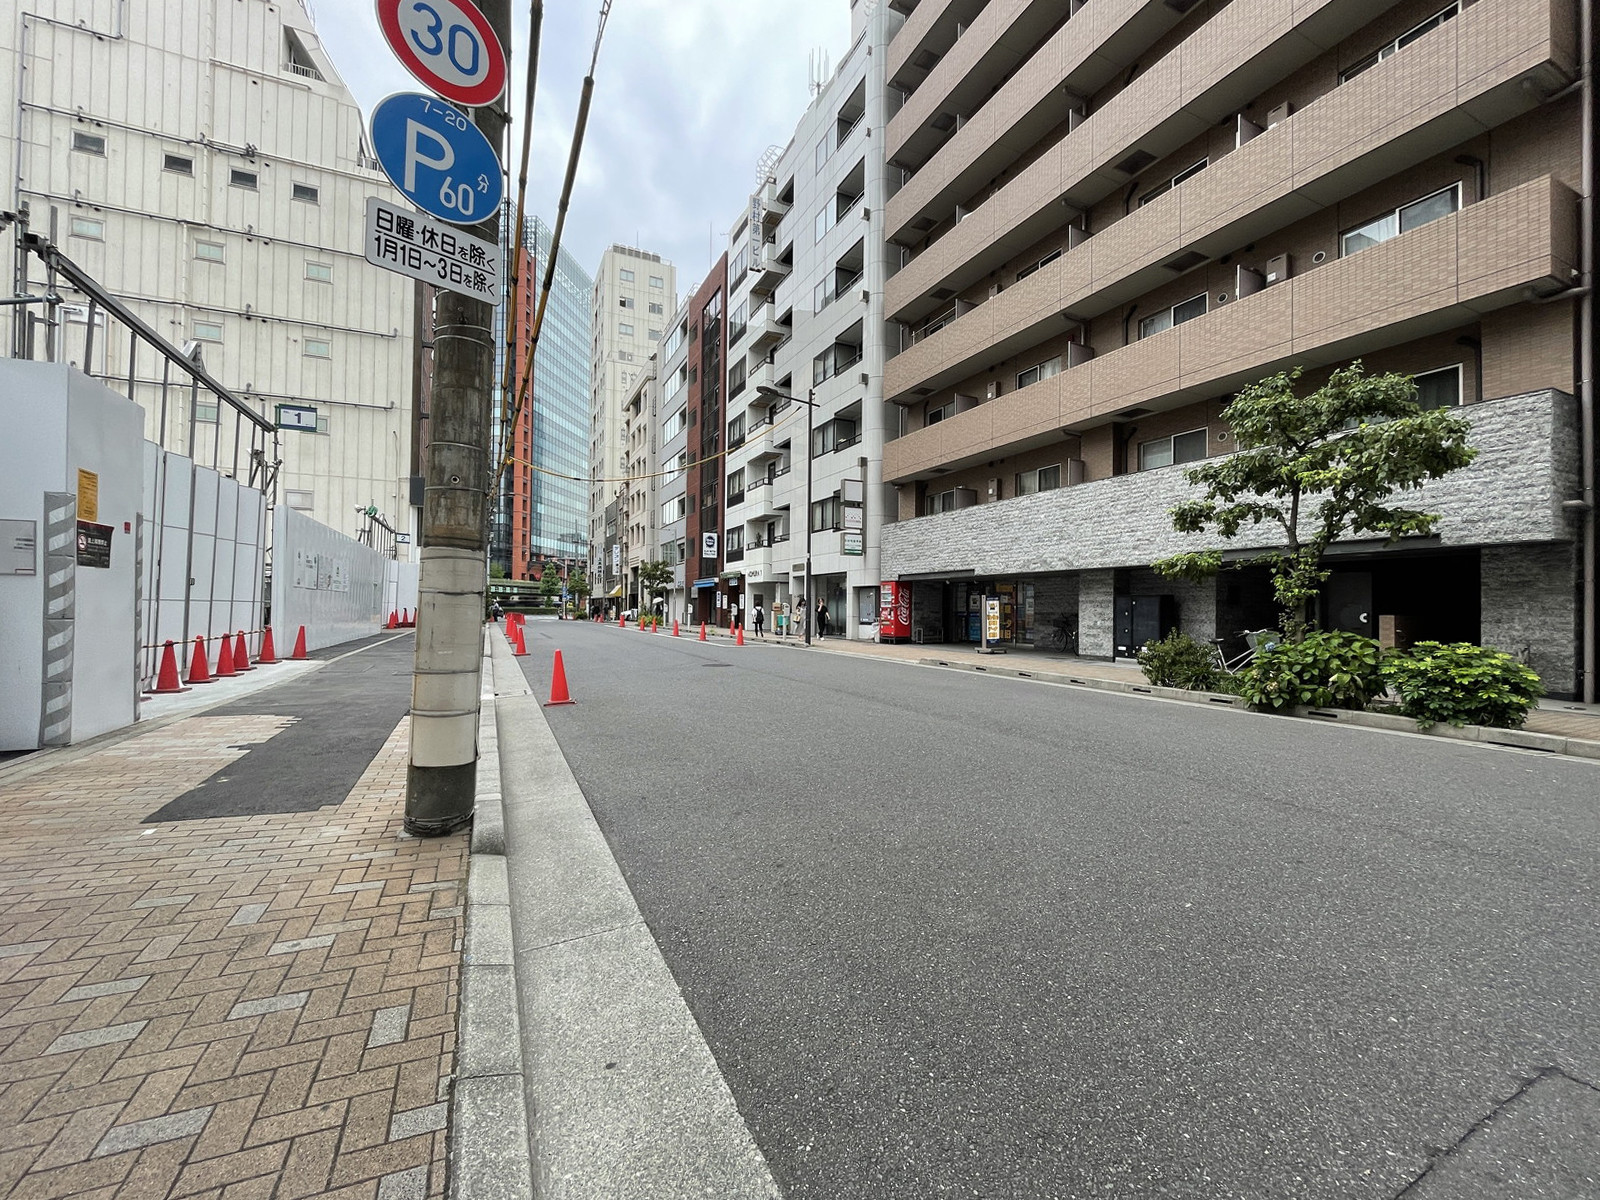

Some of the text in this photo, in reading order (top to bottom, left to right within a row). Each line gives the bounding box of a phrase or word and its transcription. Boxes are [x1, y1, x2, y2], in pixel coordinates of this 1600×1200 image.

[411, 2, 479, 76] 30
[419, 97, 468, 133] 7-20
[404, 117, 456, 194] P
[752, 197, 761, 268] 野村第一ビル
[294, 412, 302, 424] 1
